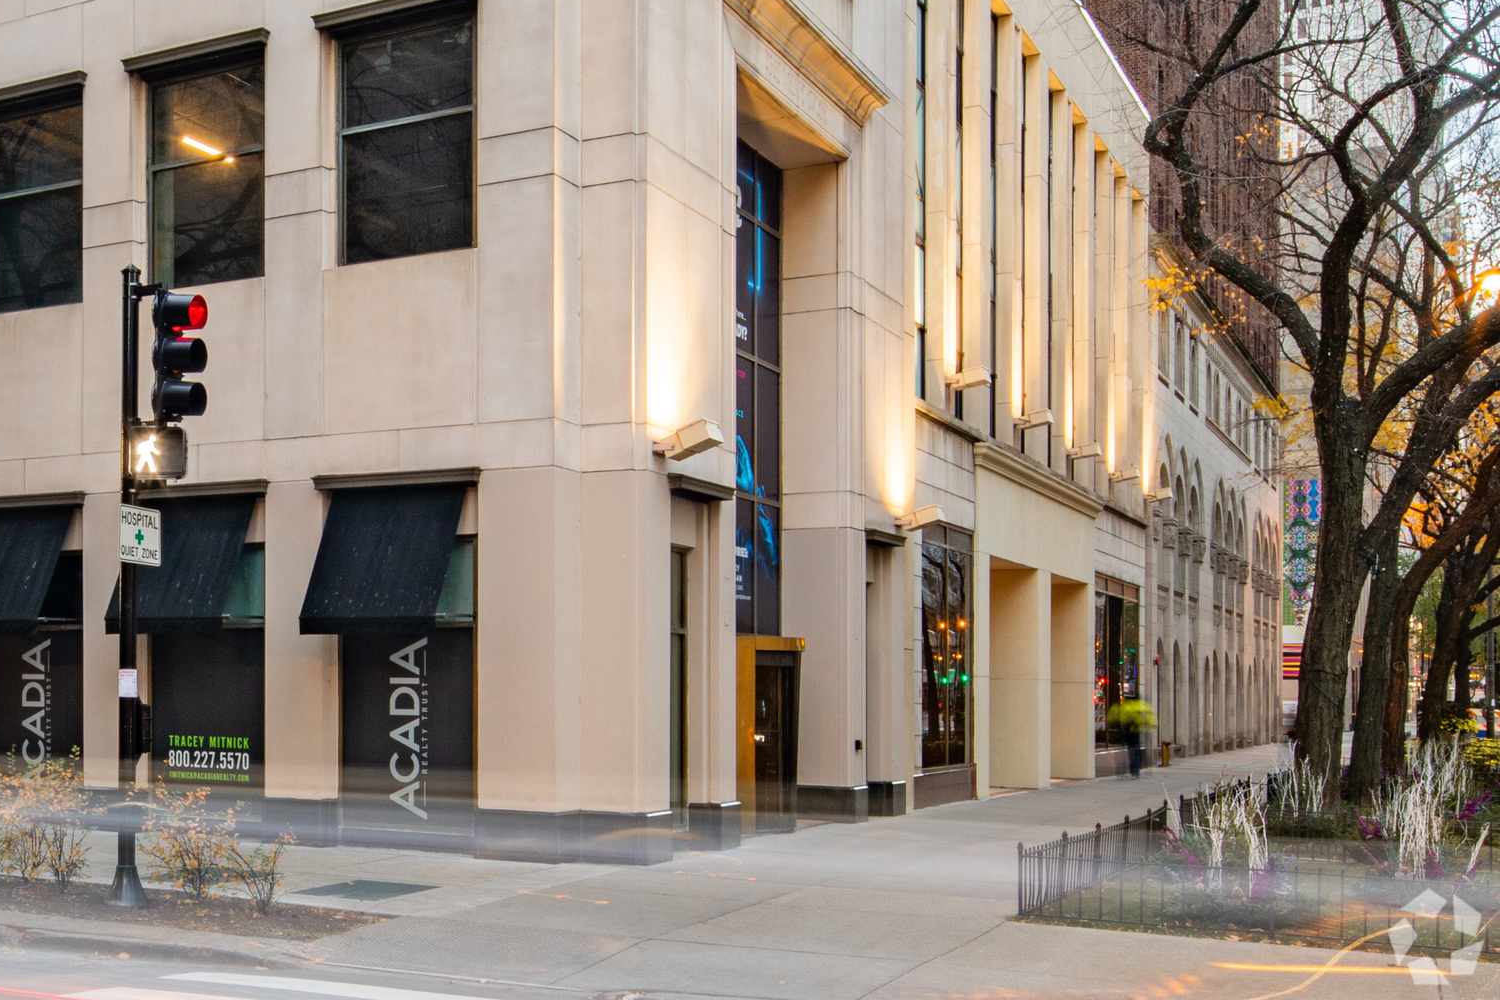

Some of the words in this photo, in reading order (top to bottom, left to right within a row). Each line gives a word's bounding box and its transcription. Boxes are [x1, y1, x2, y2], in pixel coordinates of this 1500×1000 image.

[121, 510, 159, 530] HOSPITAL
[120, 544, 139, 557] QUIET
[141, 547, 159, 561] ZONE
[389, 636, 428, 820] ACADIA
[169, 735, 204, 747] TRACEY
[209, 736, 249, 749] MITNICK
[168, 749, 250, 770] 800.227.5570
